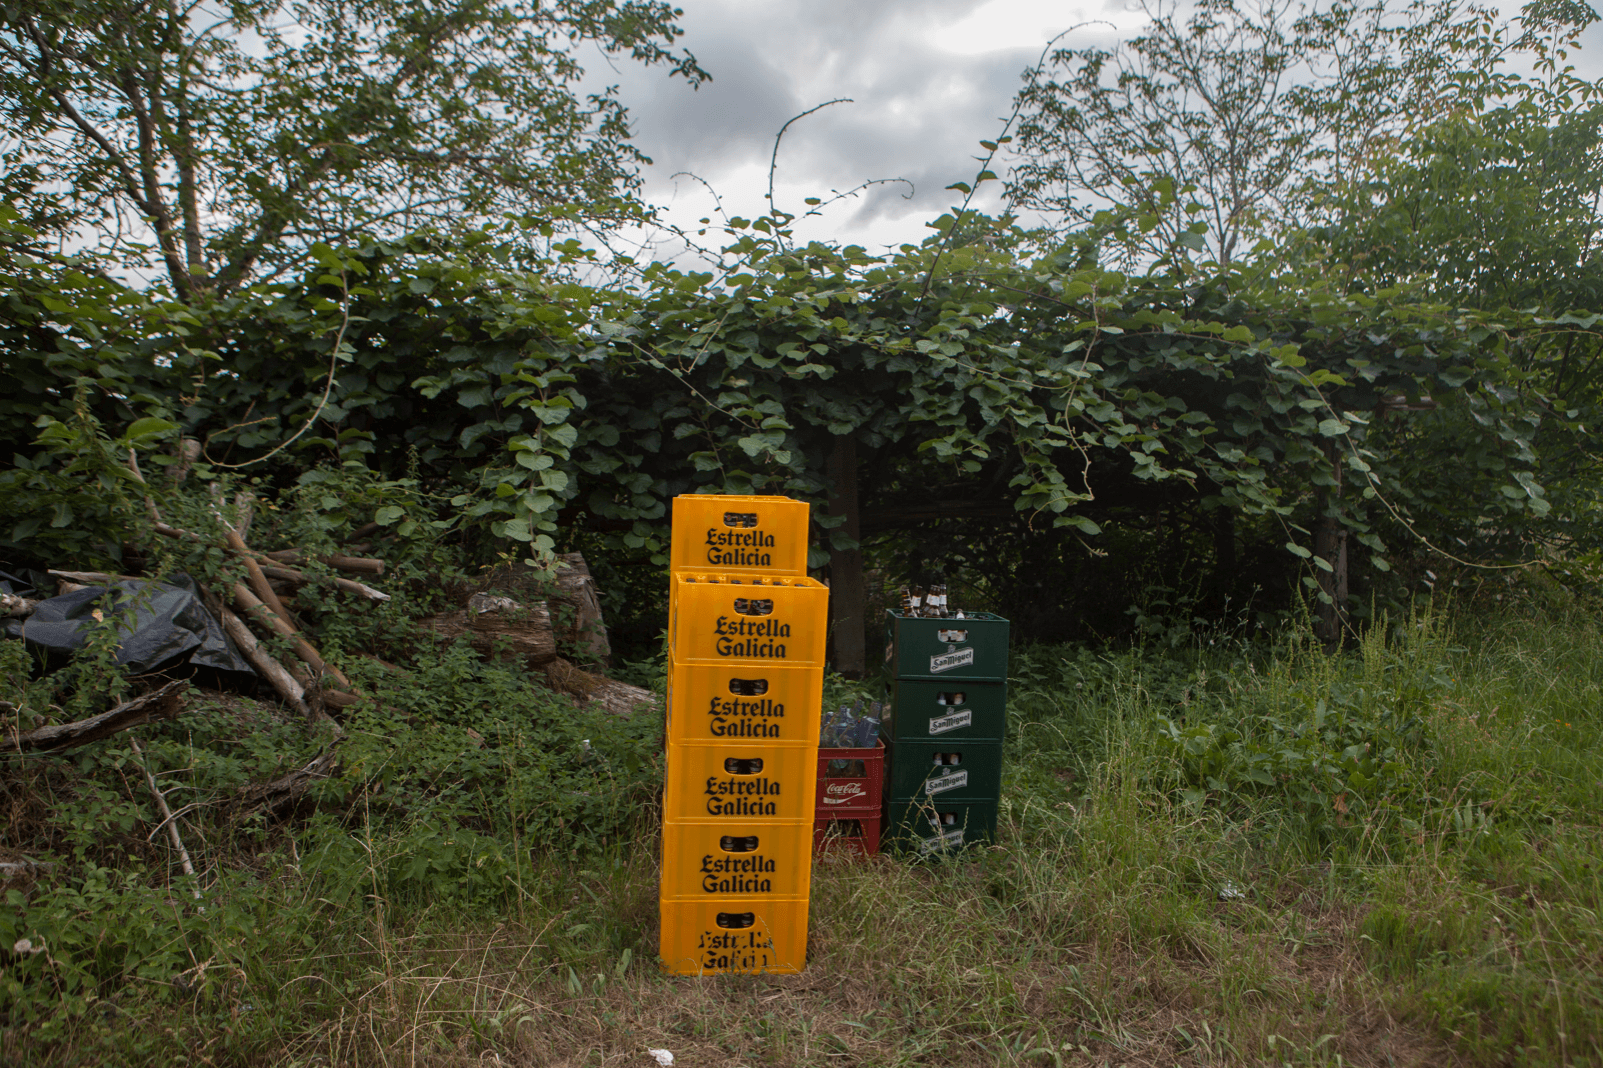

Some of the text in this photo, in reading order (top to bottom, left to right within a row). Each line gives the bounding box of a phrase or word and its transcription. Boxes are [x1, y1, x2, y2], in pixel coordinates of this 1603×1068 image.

[705, 527, 775, 547] Estrella
[707, 547, 771, 566] Galicia
[714, 616, 791, 638] Estrella
[716, 637, 787, 658] Galicia
[708, 696, 785, 718] Estrella
[710, 717, 780, 738] Galicia
[704, 776, 781, 796] Estrella
[706, 797, 776, 816] Galicia
[700, 854, 776, 873] Estrella
[702, 874, 772, 893] Galicia
